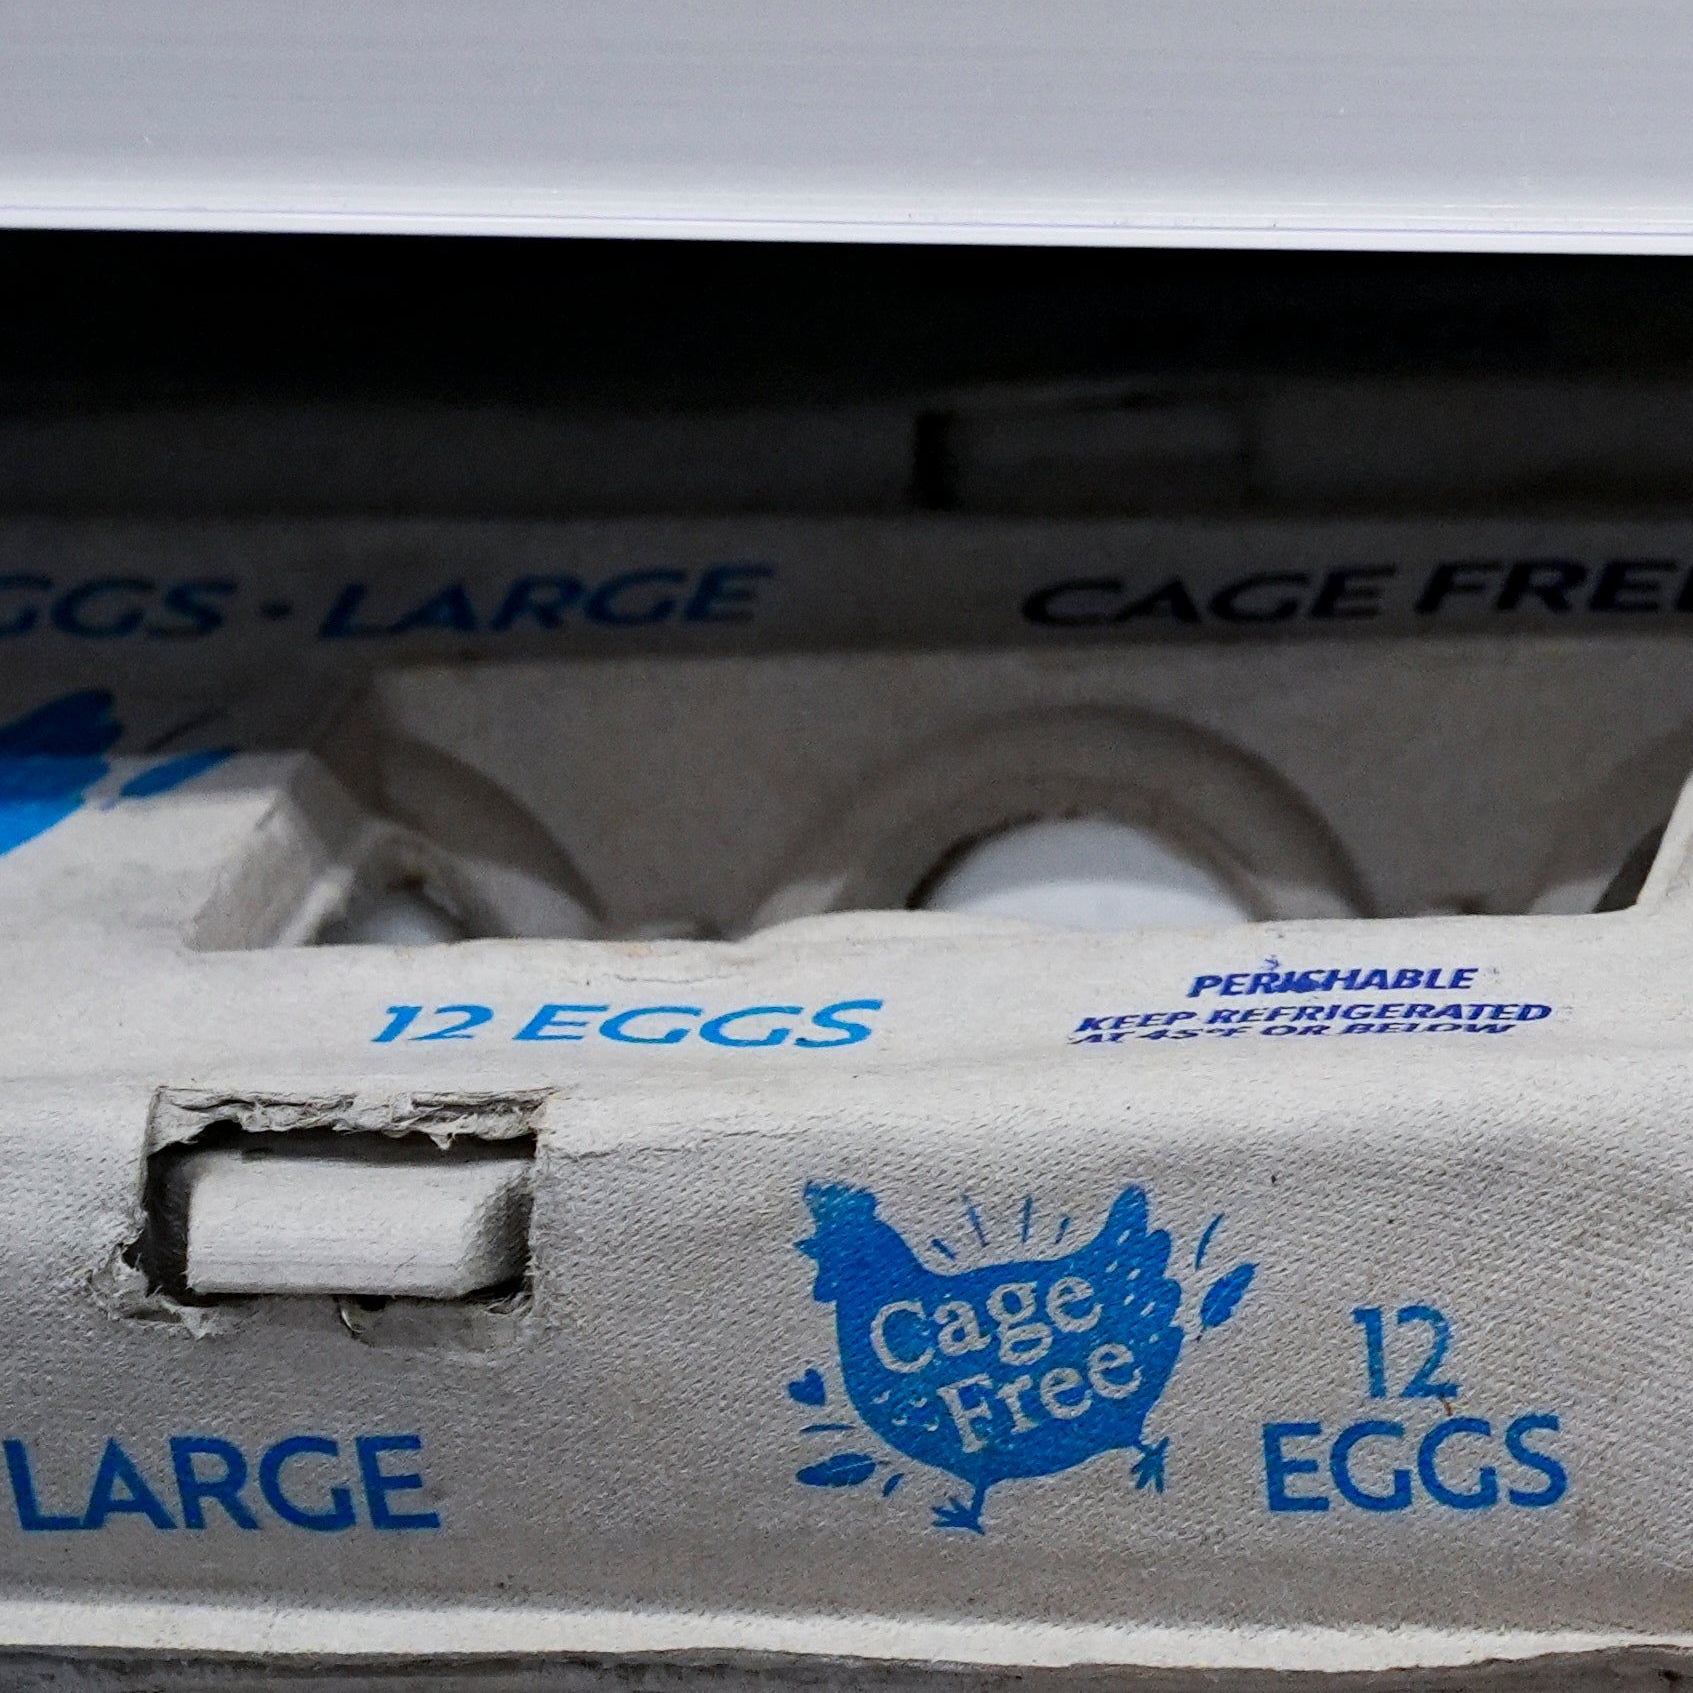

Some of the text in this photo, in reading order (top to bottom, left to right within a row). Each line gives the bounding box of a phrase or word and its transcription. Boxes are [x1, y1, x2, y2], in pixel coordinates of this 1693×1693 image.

[318, 563, 774, 640] LARGE
[1022, 563, 1396, 628] CAGE
[371, 999, 884, 1049] 12 EGGS
[1074, 1003, 1553, 1034] KEEP REFRIGERATED
[1259, 1024, 1332, 1036] OR
[870, 1273, 1103, 1376] Cage
[1353, 1305, 1457, 1400] 12
[936, 1338, 1143, 1455] Free
[4, 1435, 441, 1532] LARGE
[1262, 1414, 1570, 1513] EGGS
